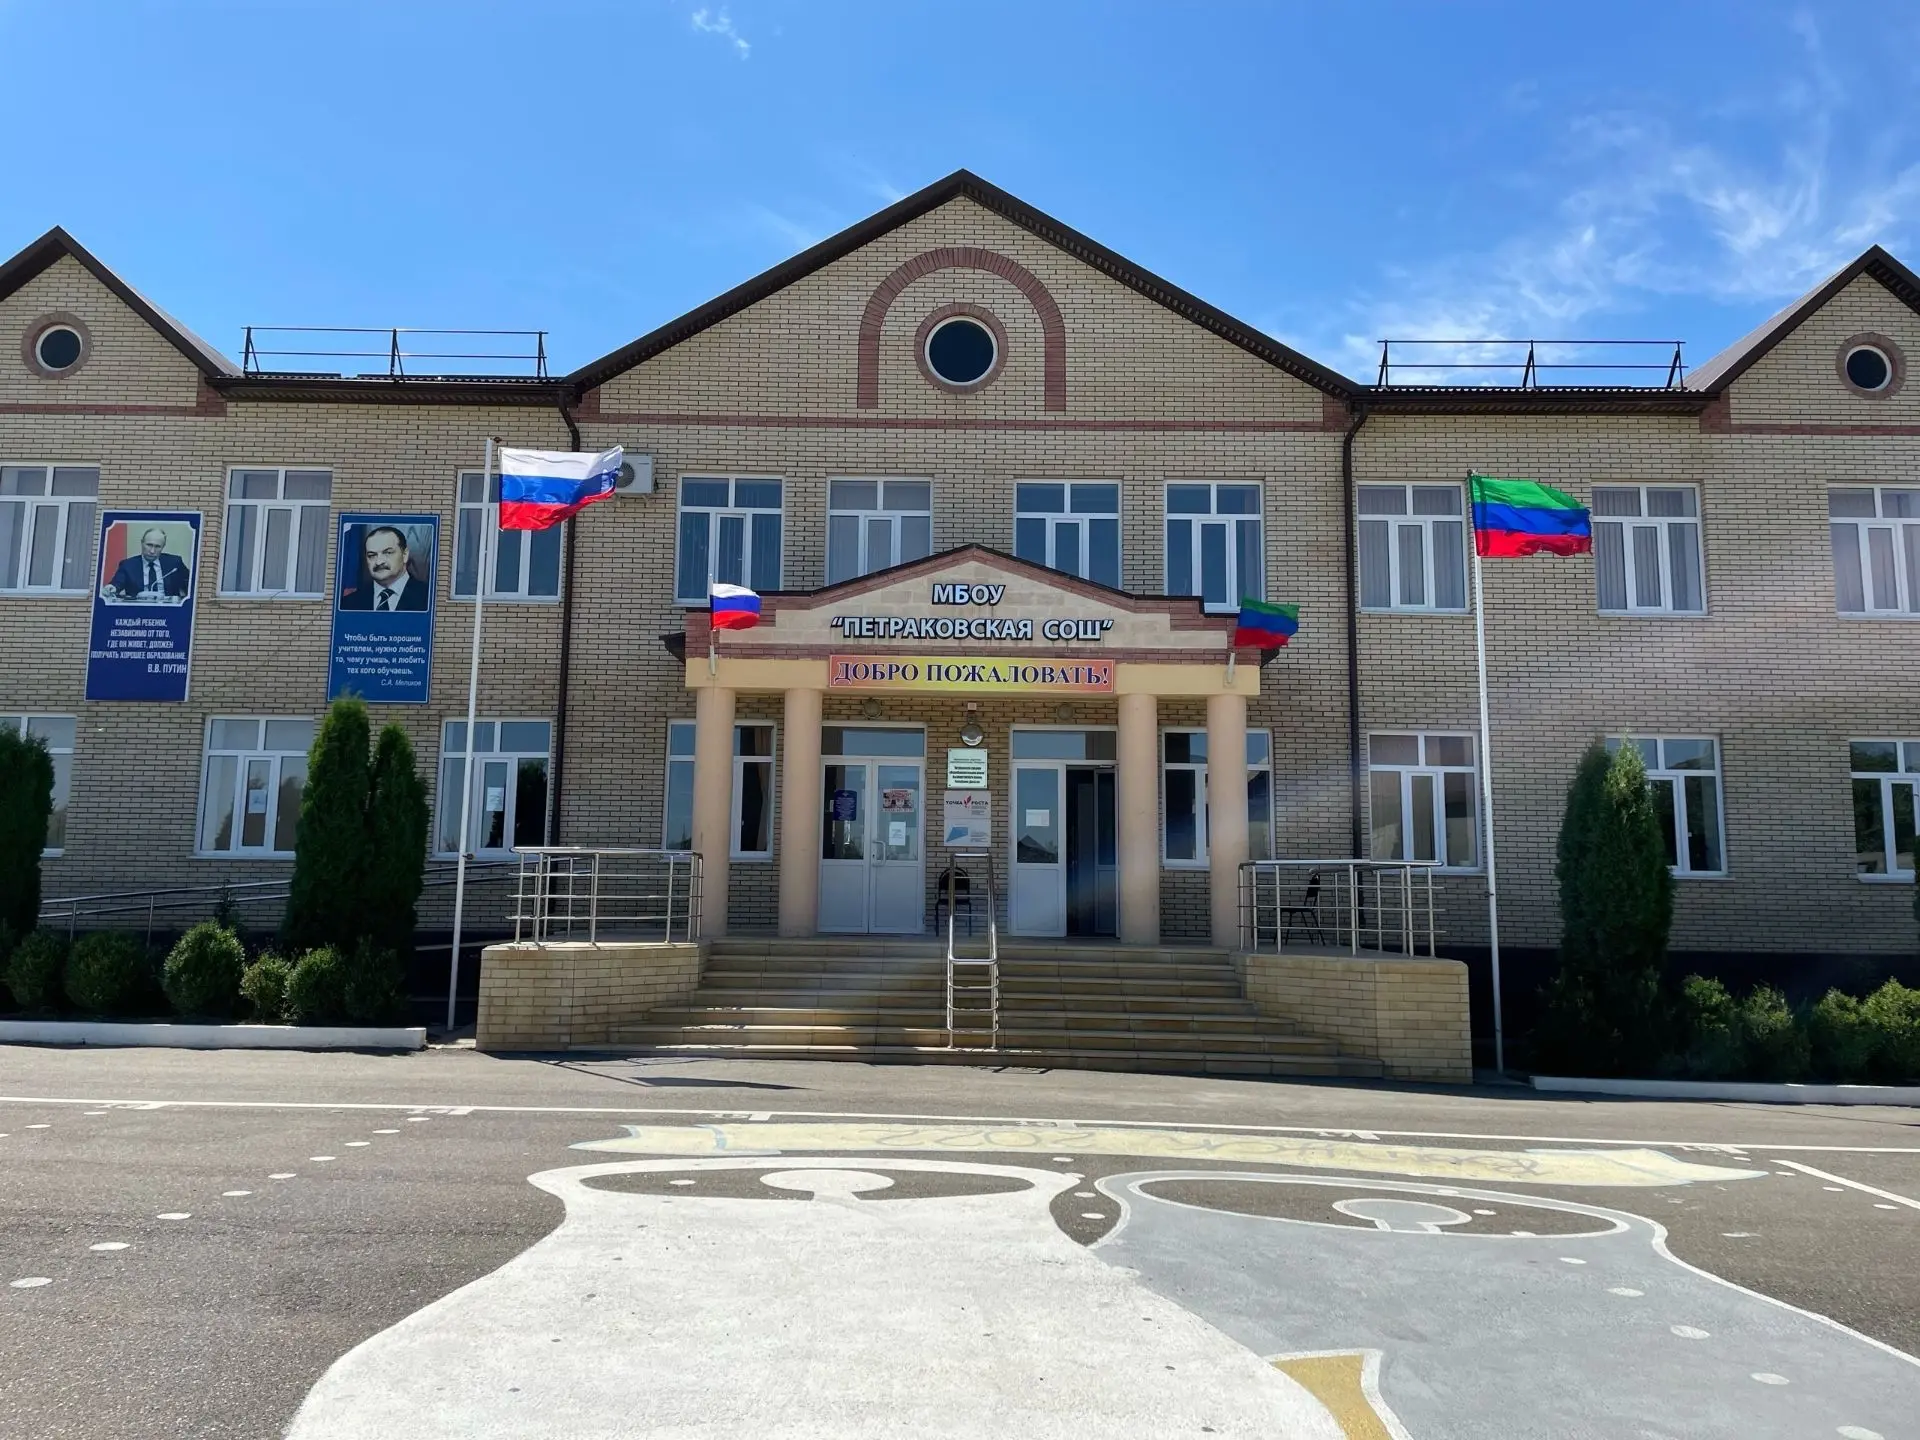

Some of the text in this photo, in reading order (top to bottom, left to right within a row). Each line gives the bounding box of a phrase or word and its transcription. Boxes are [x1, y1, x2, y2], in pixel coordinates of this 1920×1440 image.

[931, 583, 1006, 605] МБОУ
[115, 617, 168, 627] КАЖДЫЙ РЕБЕНОК,
[110, 629, 147, 637] НЕЗАВИСИМО
[155, 630, 171, 638] ТОГО,
[344, 633, 421, 643] Чтобы быть хорошим
[107, 640, 118, 649] ГДЕ
[118, 640, 127, 648] ОН
[149, 640, 174, 649] ДОЛЖЕН
[337, 645, 426, 654] учителем, нужно любить
[90, 650, 119, 659] ПОЛУЧАТЬ
[119, 651, 146, 659] ХОРОШЕЕ
[335, 656, 345, 664] то,
[346, 656, 364, 665] чему
[365, 657, 391, 665] учишь,
[397, 656, 426, 664] любить
[147, 663, 187, 674] В.В. ПУТИН
[834, 662, 1109, 686] ДОБРО ПОЖАЛОВАТЬ!
[394, 679, 422, 687] Меликов
